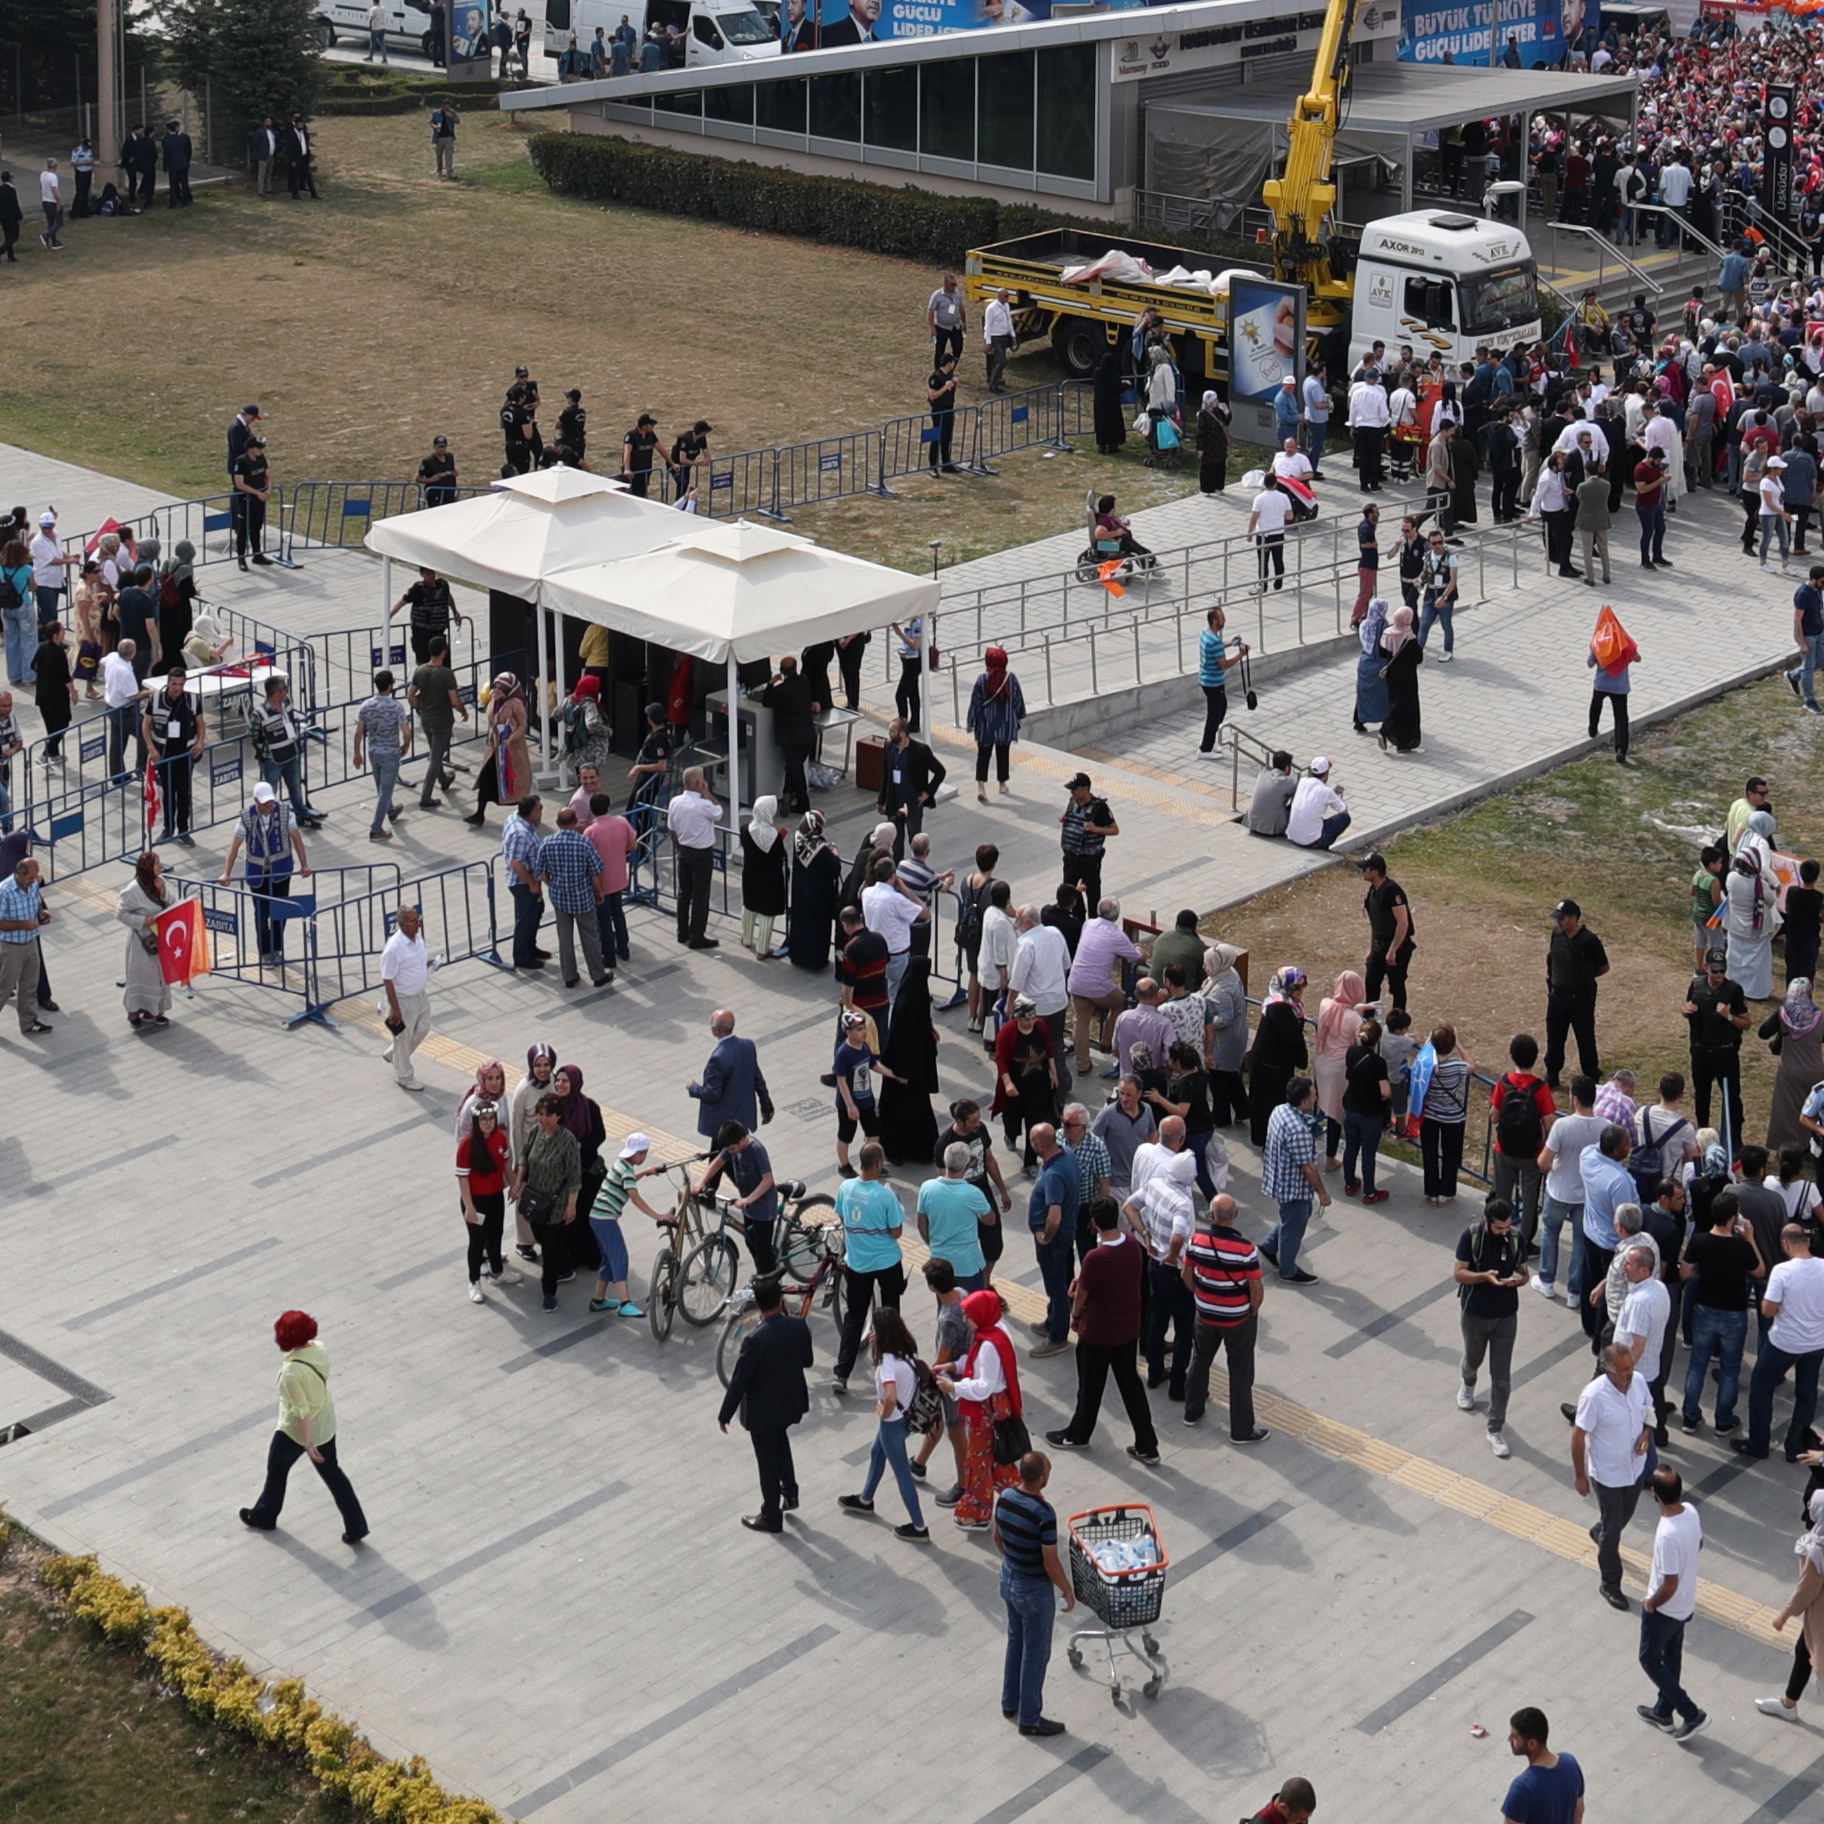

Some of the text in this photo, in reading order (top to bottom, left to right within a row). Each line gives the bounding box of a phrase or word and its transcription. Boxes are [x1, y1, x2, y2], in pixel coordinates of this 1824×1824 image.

[893, 4, 942, 22] GÜÇLÜ
[1414, 6, 1470, 37] BÜYÜK
[1415, 34, 1460, 61] GÜÇLÜ
[1379, 239, 1410, 253] AXOR
[1490, 245, 1510, 258] AVK
[214, 769, 239, 784] ZABITA
[206, 918, 235, 934] ZABITA
